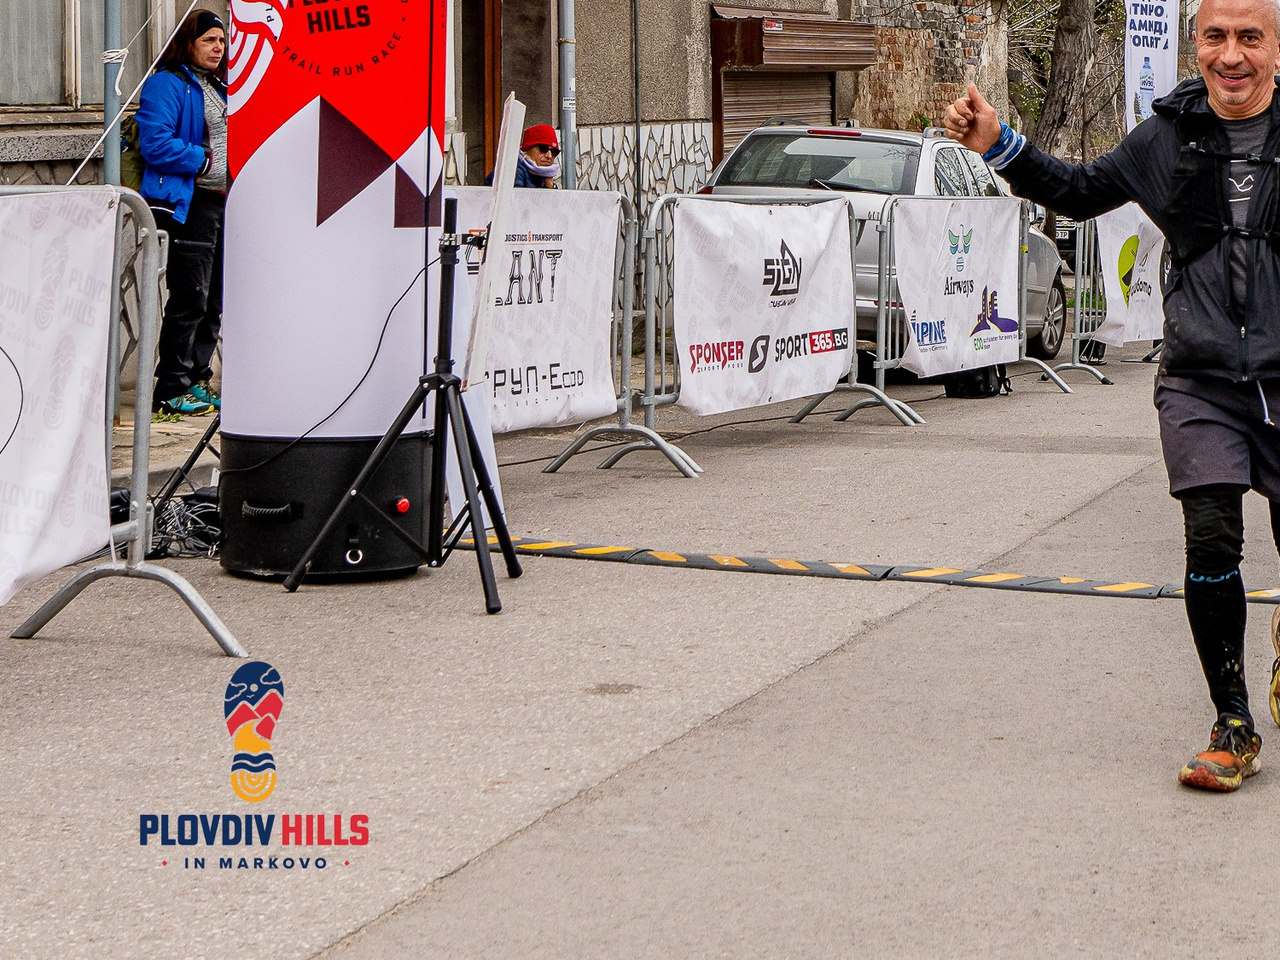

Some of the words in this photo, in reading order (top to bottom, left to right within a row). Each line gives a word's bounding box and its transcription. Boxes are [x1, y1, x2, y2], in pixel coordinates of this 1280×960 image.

[306, 4, 372, 35] HILLS
[281, 45, 322, 75] TRAIL
[332, 62, 365, 77] RUN
[371, 32, 402, 66] RACE
[532, 233, 563, 242] TRANSPORT
[495, 249, 563, 306] ANT
[944, 276, 974, 298] Airways
[774, 332, 808, 363] SPORT
[911, 320, 946, 344] LPINE
[689, 340, 744, 375] SPONSER
